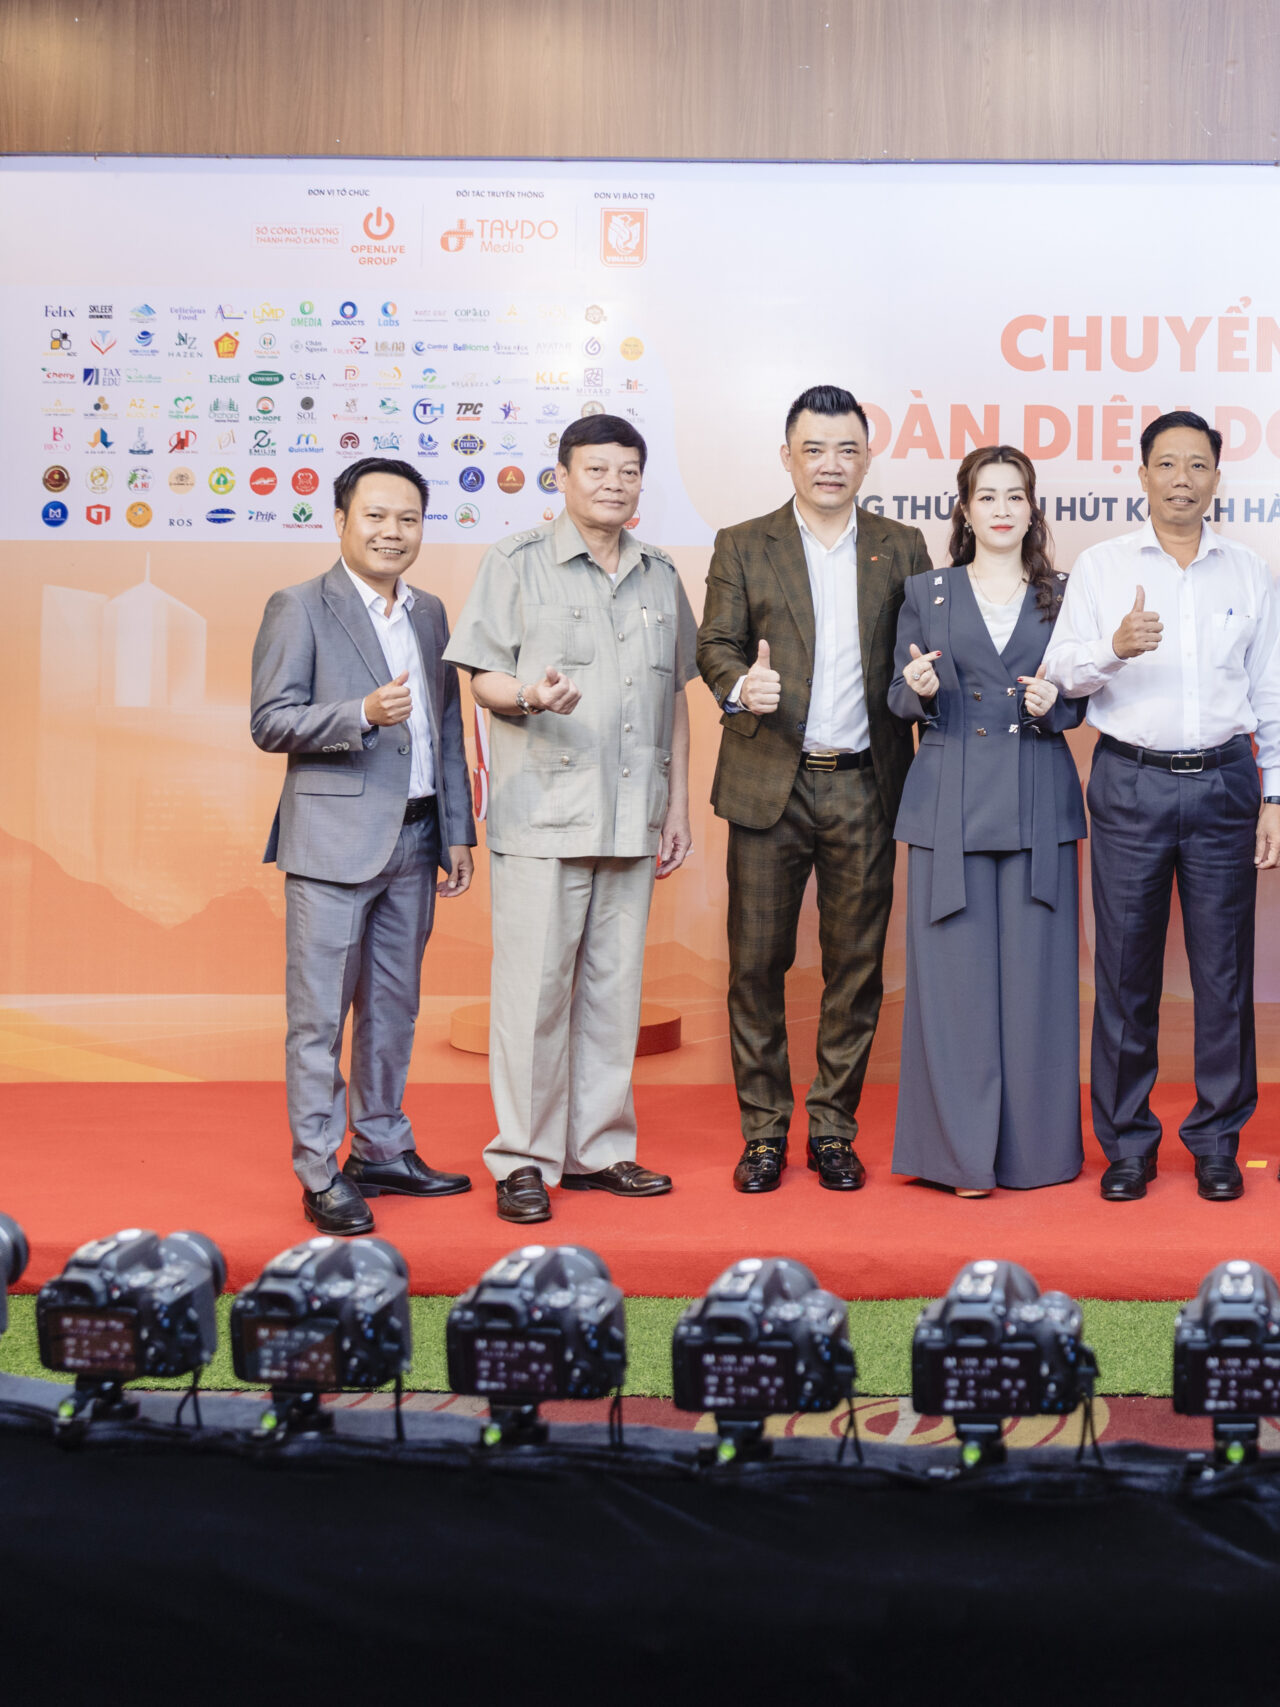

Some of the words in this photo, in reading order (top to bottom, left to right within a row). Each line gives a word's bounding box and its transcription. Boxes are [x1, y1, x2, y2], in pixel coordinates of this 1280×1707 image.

[477, 219, 559, 240] TAYDO
[351, 245, 406, 255] OPENLIVE
[480, 241, 525, 254] Media
[358, 257, 398, 267] GROUP
[44, 304, 78, 319] Felix
[290, 317, 323, 328] OMEDIA
[377, 317, 401, 328] Labs
[167, 351, 204, 359] HAZEN
[105, 367, 121, 377] TAX
[105, 377, 122, 387] EDU
[535, 371, 569, 385] KLC
[456, 402, 484, 415] TPC
[1056, 491, 1119, 522] HÚT
[168, 518, 194, 527] ROS
